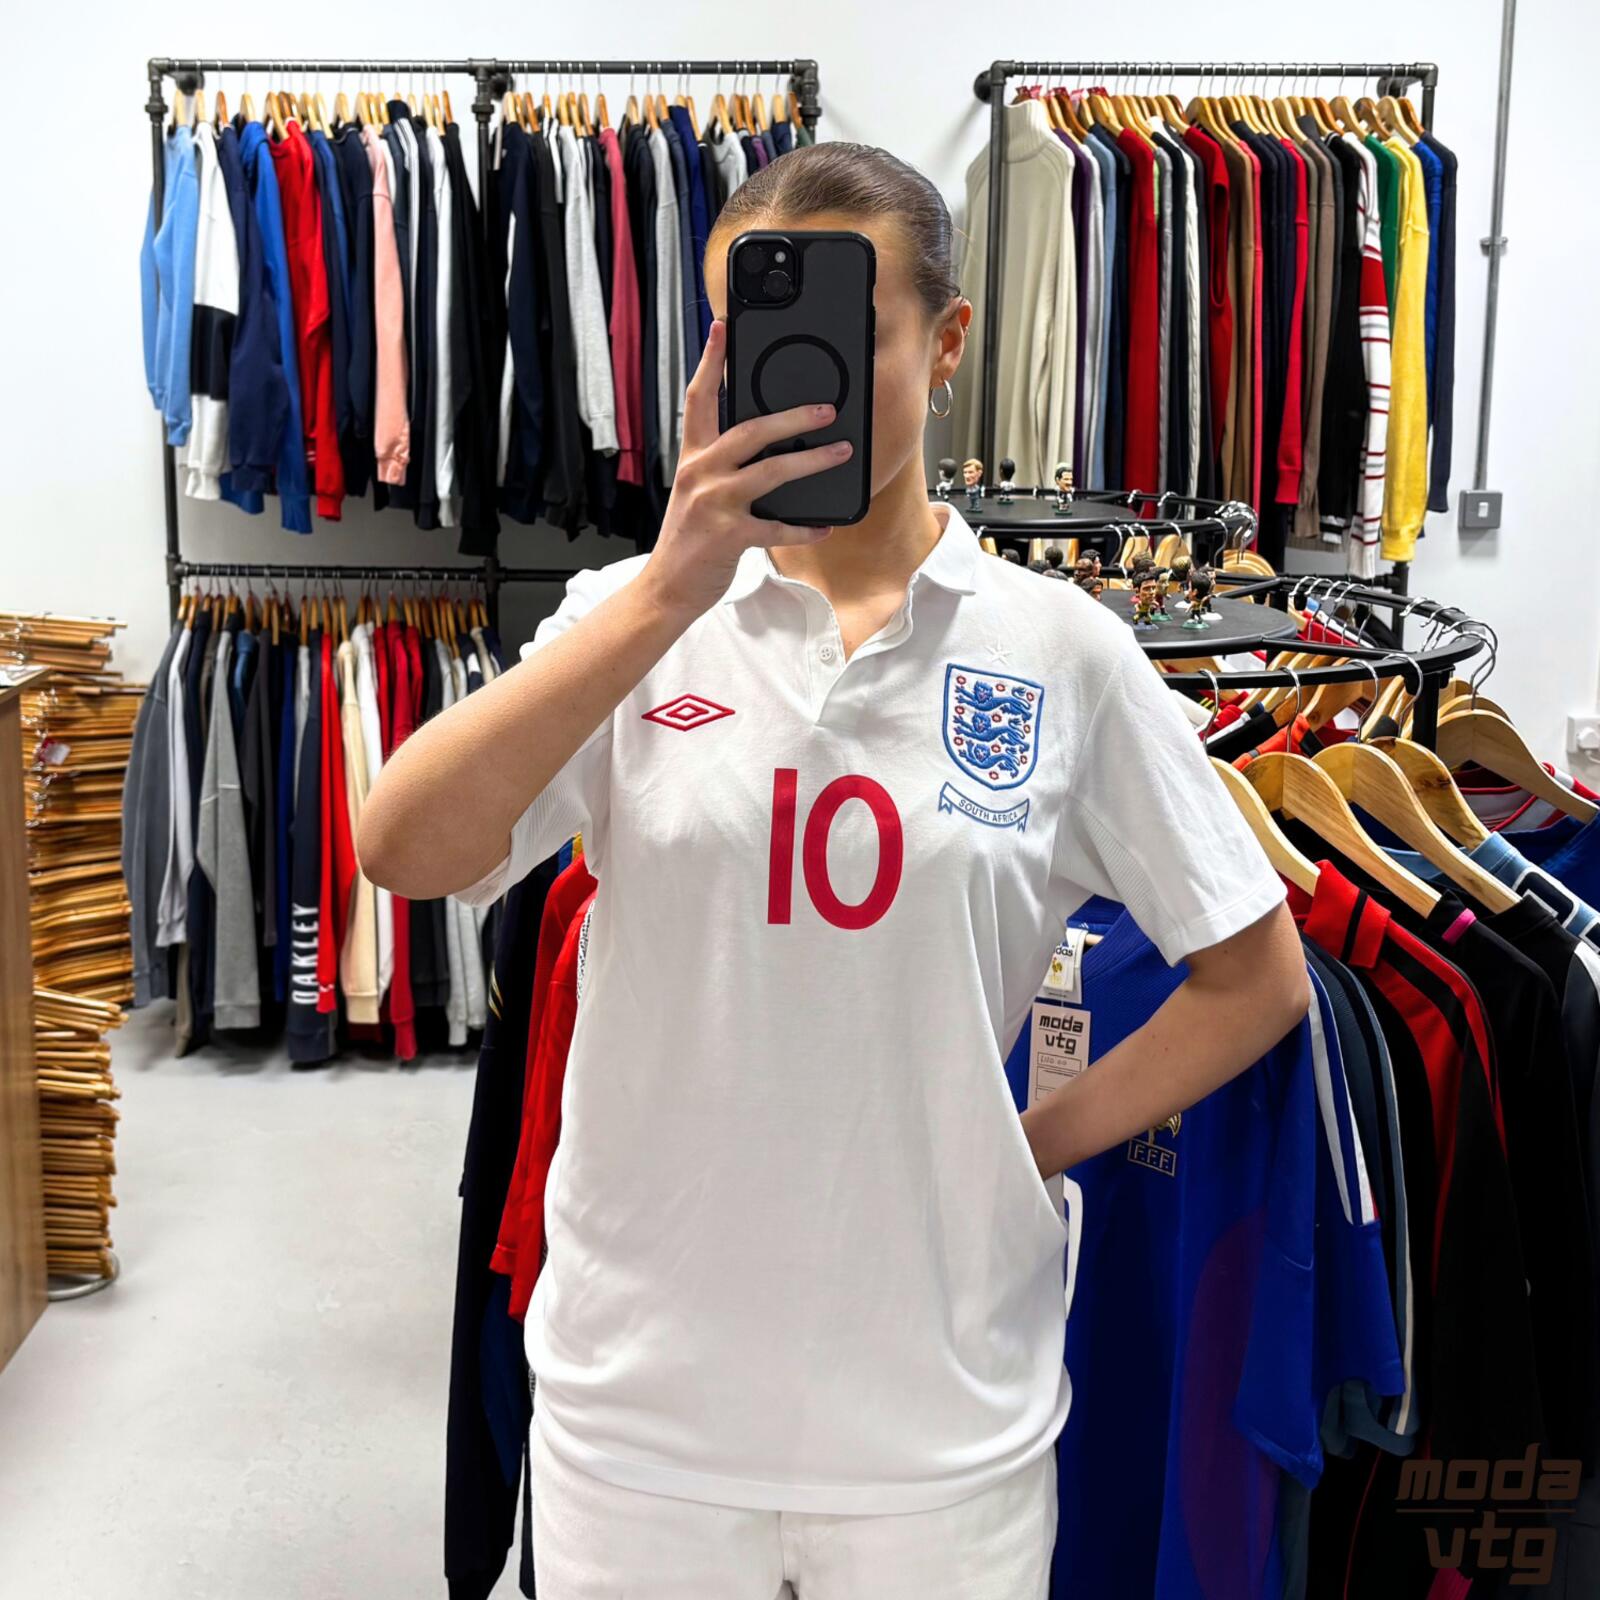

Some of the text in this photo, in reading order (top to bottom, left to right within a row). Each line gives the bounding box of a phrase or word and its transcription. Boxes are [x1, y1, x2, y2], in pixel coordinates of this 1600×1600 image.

[958, 799, 1018, 823] SOUTH AFRICA
[767, 767, 904, 930] 10
[292, 902, 319, 1004] OAKLEY
[1039, 1014, 1084, 1033] moda
[1045, 1031, 1077, 1055] vtg
